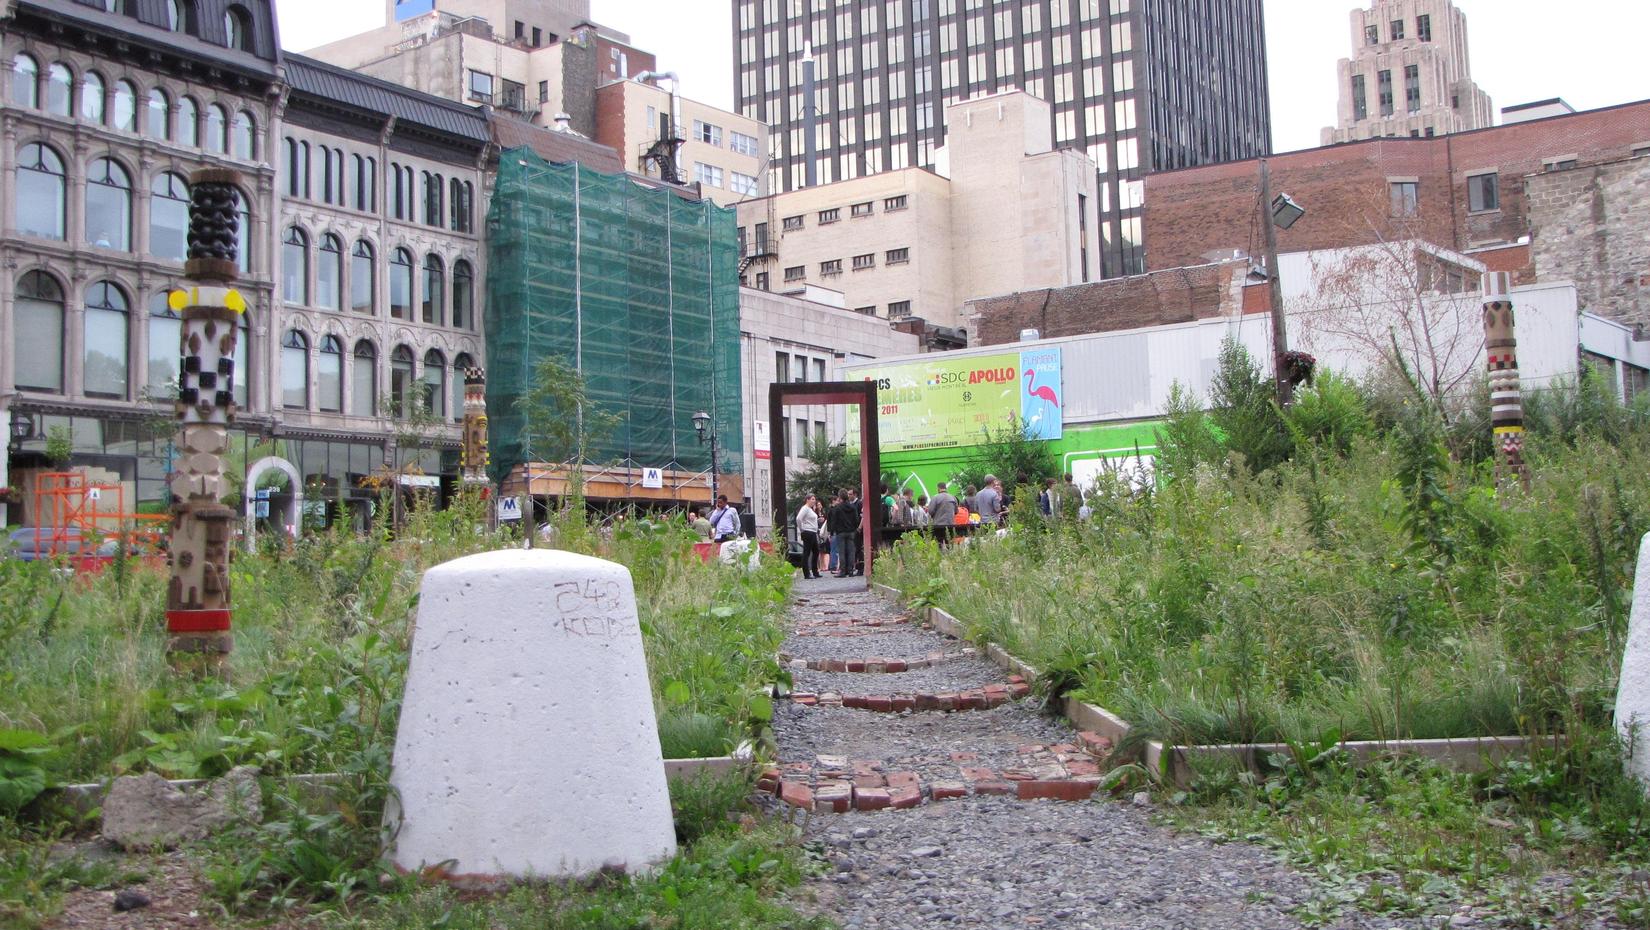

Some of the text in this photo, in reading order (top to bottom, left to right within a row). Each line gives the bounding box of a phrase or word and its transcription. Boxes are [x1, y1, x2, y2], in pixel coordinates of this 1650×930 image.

[941, 371, 966, 384] SDC
[968, 367, 1015, 384] APOLLO
[881, 405, 898, 415] 2011
